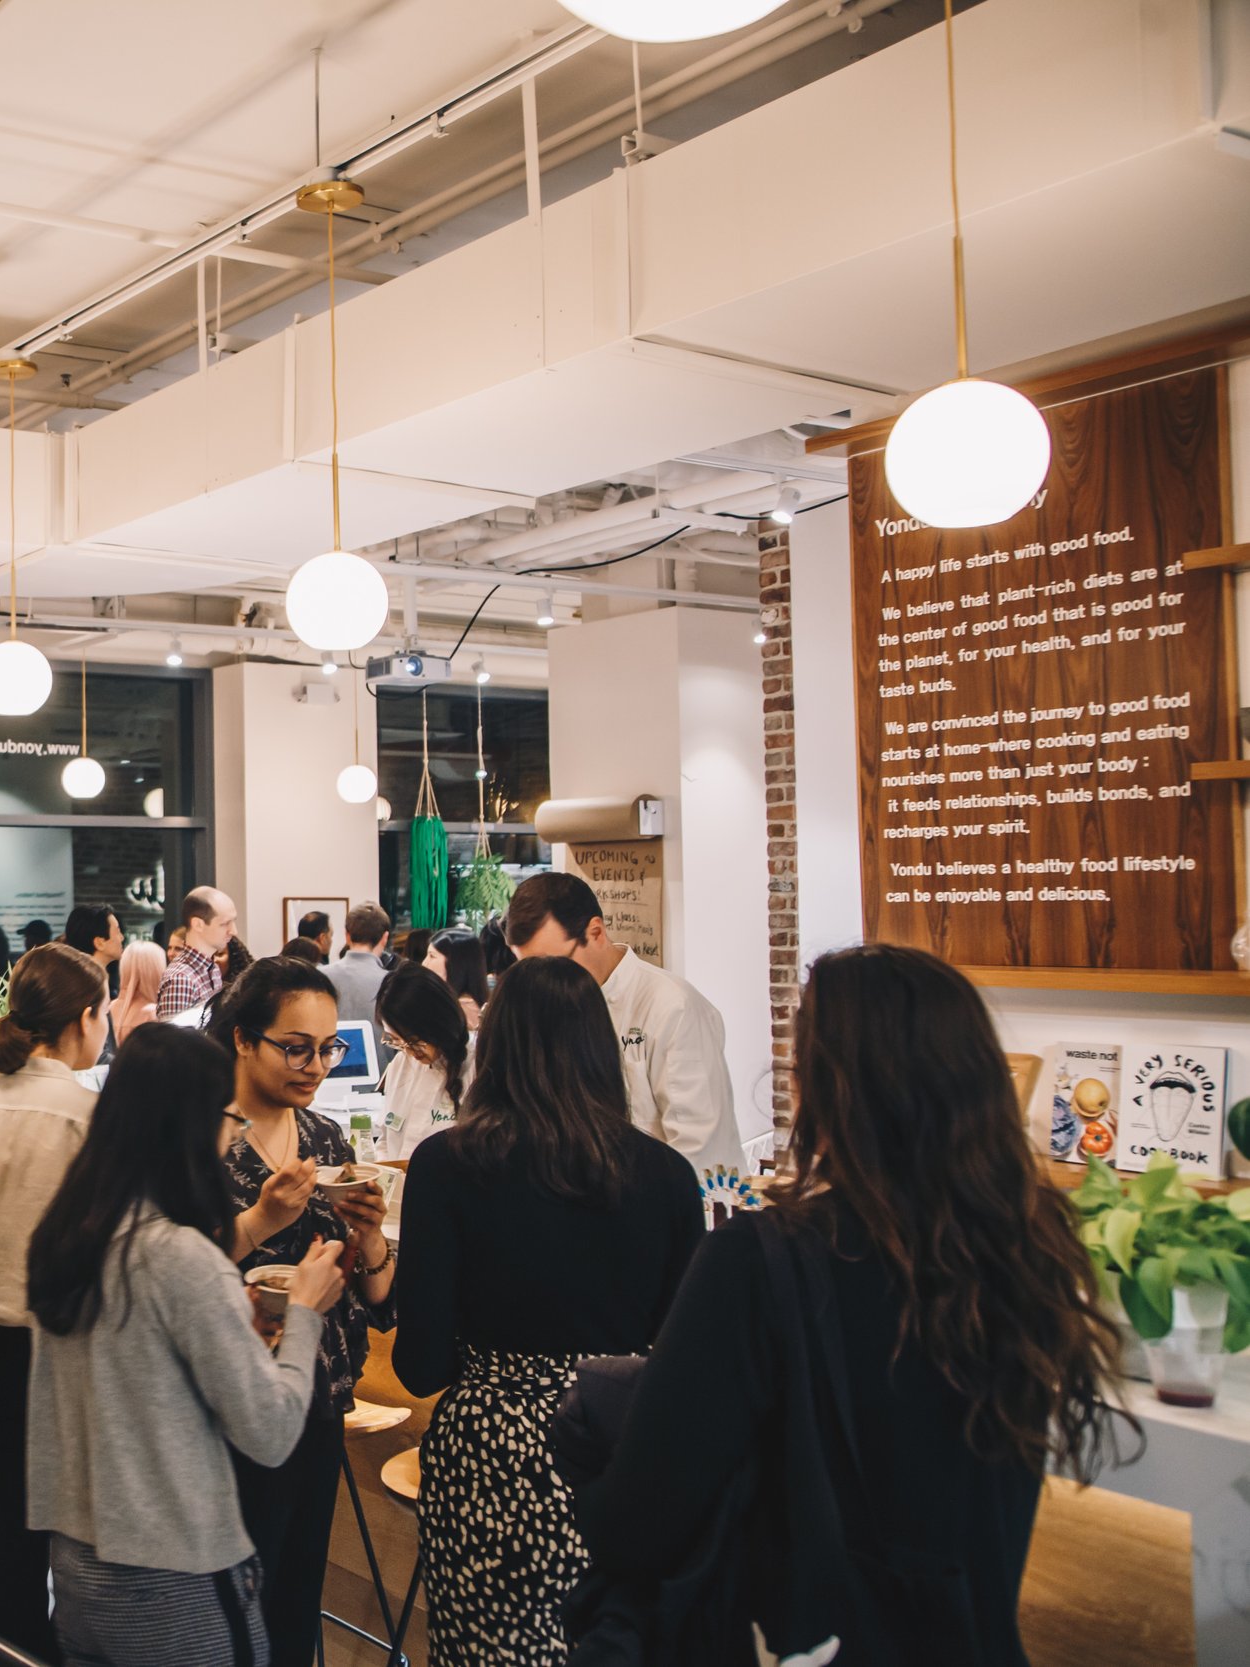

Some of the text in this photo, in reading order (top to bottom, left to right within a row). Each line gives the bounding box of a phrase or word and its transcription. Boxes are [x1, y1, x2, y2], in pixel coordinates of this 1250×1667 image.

[881, 526, 1134, 584] A happy life starts with good food.
[882, 606, 902, 621] We
[907, 600, 955, 617] believe
[959, 591, 991, 609] that
[1083, 571, 1124, 590] diets
[1130, 568, 1158, 582] are
[1165, 560, 1184, 577] at
[877, 591, 1184, 647] the center of good food that is good for
[878, 622, 1186, 673] the planet, for your health, and for your
[879, 677, 957, 698] taste buds.
[884, 691, 1190, 735] We are convinced the journey to good food
[881, 746, 921, 762] starts
[925, 743, 940, 758] at
[1035, 731, 1096, 749] cooking
[1100, 726, 1131, 744] and
[1136, 723, 1190, 741] eating
[881, 771, 946, 787] nourishes
[949, 770, 984, 783] more
[987, 765, 1021, 780] than
[1024, 761, 1055, 780] just
[1058, 762, 1094, 778] your
[1097, 756, 1138, 773] body
[887, 781, 1191, 813] it feeds relationships, builds bonds, and
[883, 818, 1030, 840] recharges your spirit.
[575, 850, 639, 865] UPCOMING
[890, 855, 1196, 877] Yondu believes a healthy food lifestyle
[592, 867, 635, 881] EVENTS
[885, 886, 1111, 904] can be enjoyable and delicious.
[1066, 1049, 1119, 1061] waste not
[1134, 1054, 1164, 1085] VERY
[1174, 1054, 1216, 1112] SERIOUS
